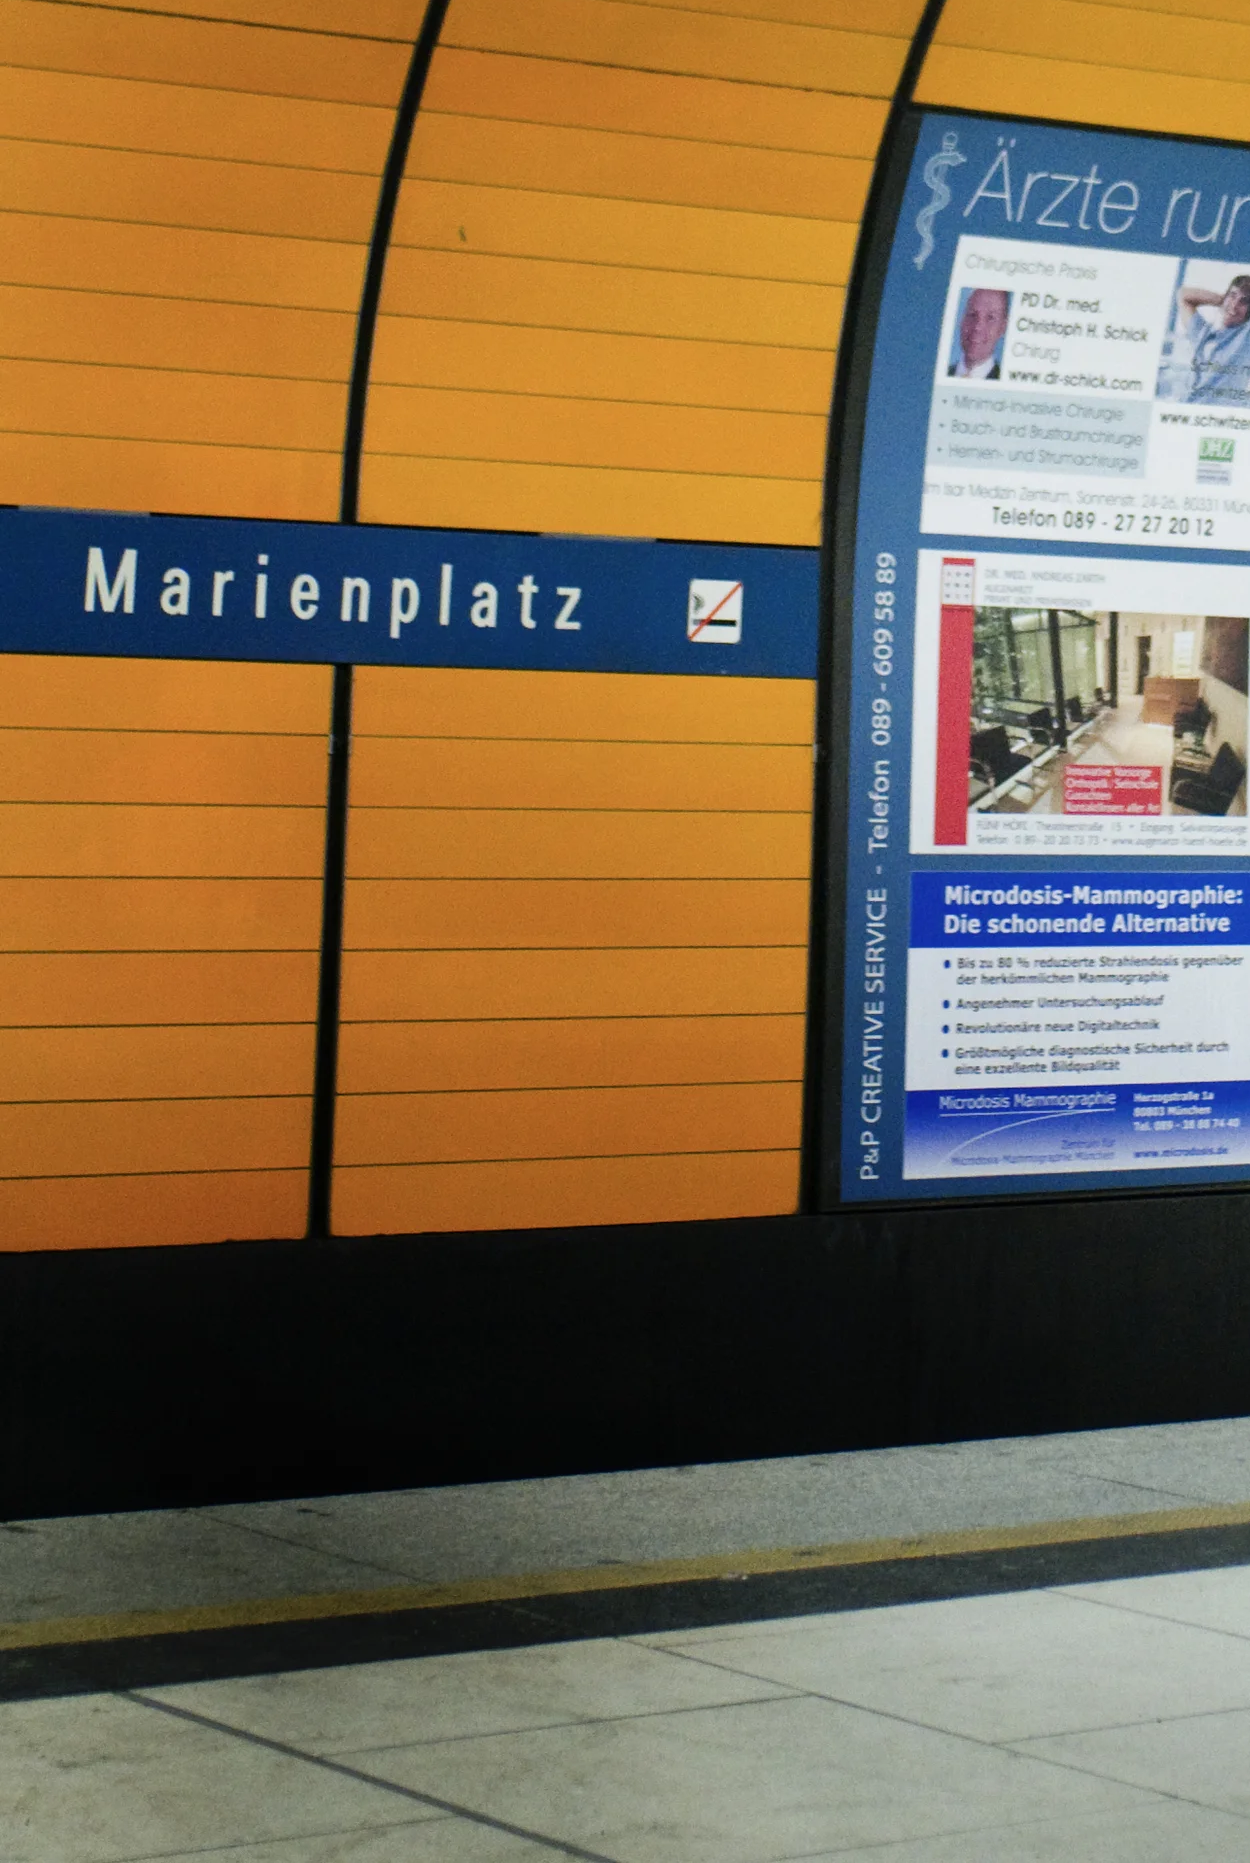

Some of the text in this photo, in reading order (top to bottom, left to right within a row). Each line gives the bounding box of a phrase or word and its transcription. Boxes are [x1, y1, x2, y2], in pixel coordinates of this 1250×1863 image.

[963, 137, 1140, 235] Ärzte
[965, 254, 1098, 280] Chirurgische Praxis
[1021, 292, 1102, 313] PD Dr. med.
[1017, 318, 1148, 342] Christoph H. Schick
[1012, 342, 1061, 363] Chirurg
[1008, 369, 1143, 392] www.dr-schick.com
[1001, 424, 1026, 438] und
[1008, 449, 1034, 463] und
[992, 505, 1214, 537] Telefon 089 27 27 20 12
[83, 546, 582, 639] Marienplatz
[859, 552, 897, 1180] P&P CREATIVE SERVICE Telefon 089 609 58 89
[945, 884, 1244, 909] Microdosis-Mammographie:
[944, 913, 1231, 935] Die schonende Alternative
[957, 957, 976, 969] Bis
[979, 959, 993, 969] zu
[1033, 955, 1095, 968] reduzierte
[1098, 955, 1179, 968] Strahlendosis
[1182, 954, 1245, 970] gegenüber
[957, 973, 978, 985] der
[1078, 970, 1170, 986] Mammographie
[956, 994, 1165, 1012] Angenehmer Untersuchungsablauf
[955, 1019, 1160, 1034] Revolutionäre neue Digitaltechnik
[1048, 1044, 1131, 1060] diagnostische
[1134, 1042, 1193, 1056] Sicherheit
[1196, 1041, 1230, 1053] durch
[955, 1059, 1121, 1075] eine exzellente Bildqualität
[939, 1091, 1116, 1110] Microdosis Mammographie
